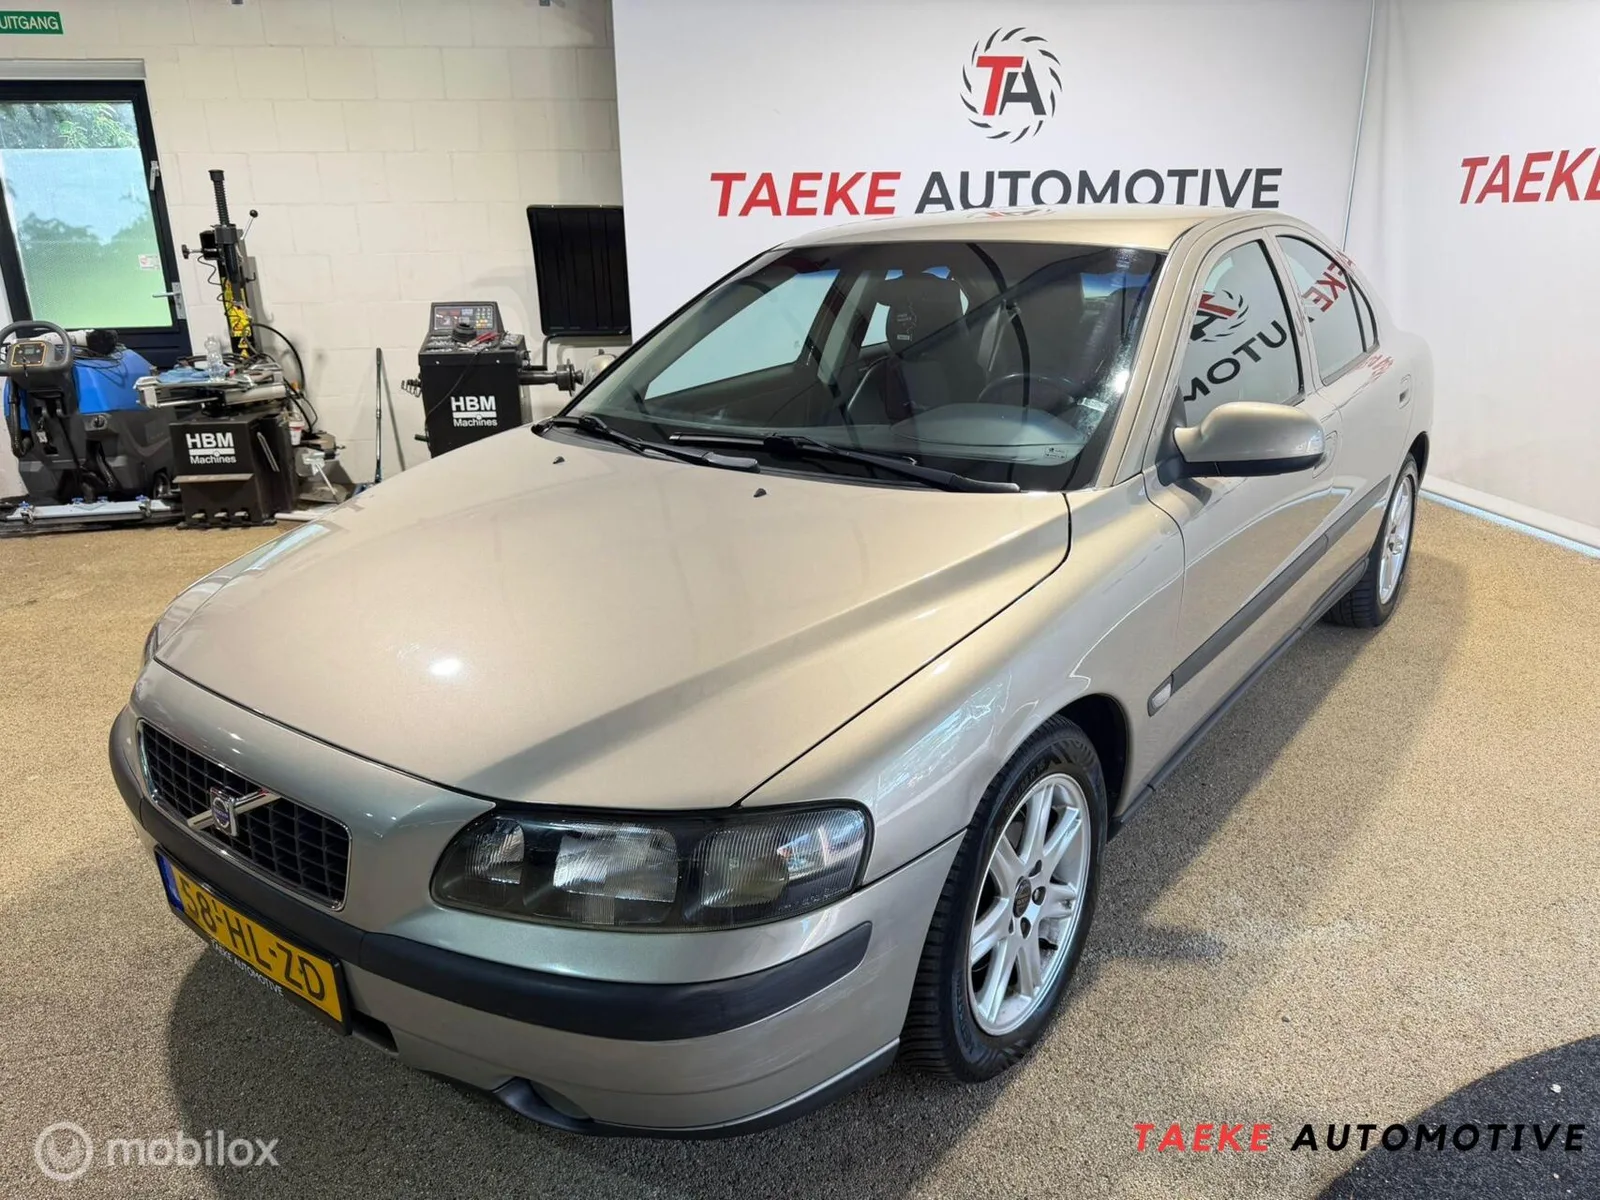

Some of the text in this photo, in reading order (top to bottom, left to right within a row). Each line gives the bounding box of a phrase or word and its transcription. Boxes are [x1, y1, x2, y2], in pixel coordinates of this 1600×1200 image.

[0, 15, 60, 30] UITGANG
[976, 56, 1047, 116] TA
[709, 168, 1283, 217] TAEKE AUTOMOTIVE
[451, 395, 496, 411] HBM
[453, 418, 498, 427] Machines
[185, 432, 234, 448] HBM
[190, 455, 237, 464] Machines
[179, 876, 326, 1001] 58-HL-ZD
